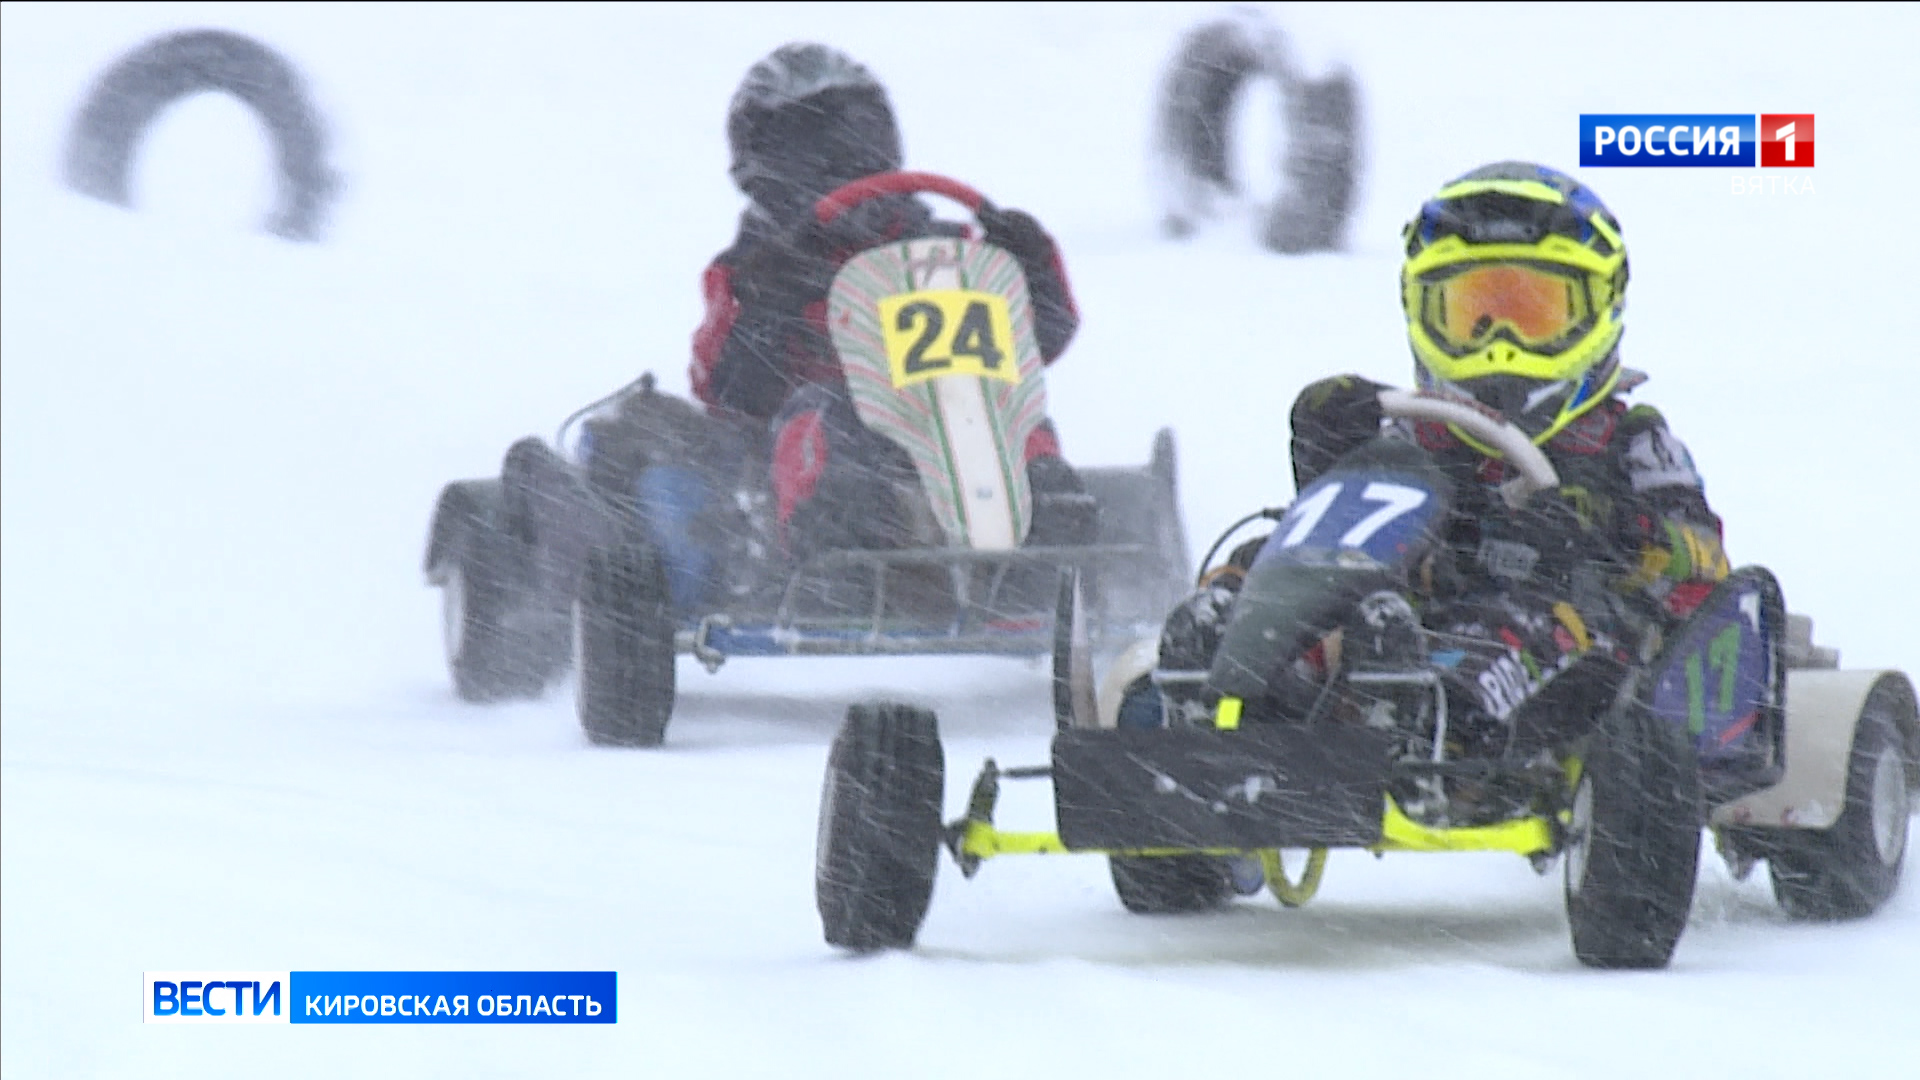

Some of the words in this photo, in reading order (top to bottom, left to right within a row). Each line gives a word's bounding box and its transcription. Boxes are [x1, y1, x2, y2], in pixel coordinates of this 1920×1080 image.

[895, 299, 1006, 374] 24
[1281, 481, 1428, 548] 17
[1686, 622, 1741, 735] 17
